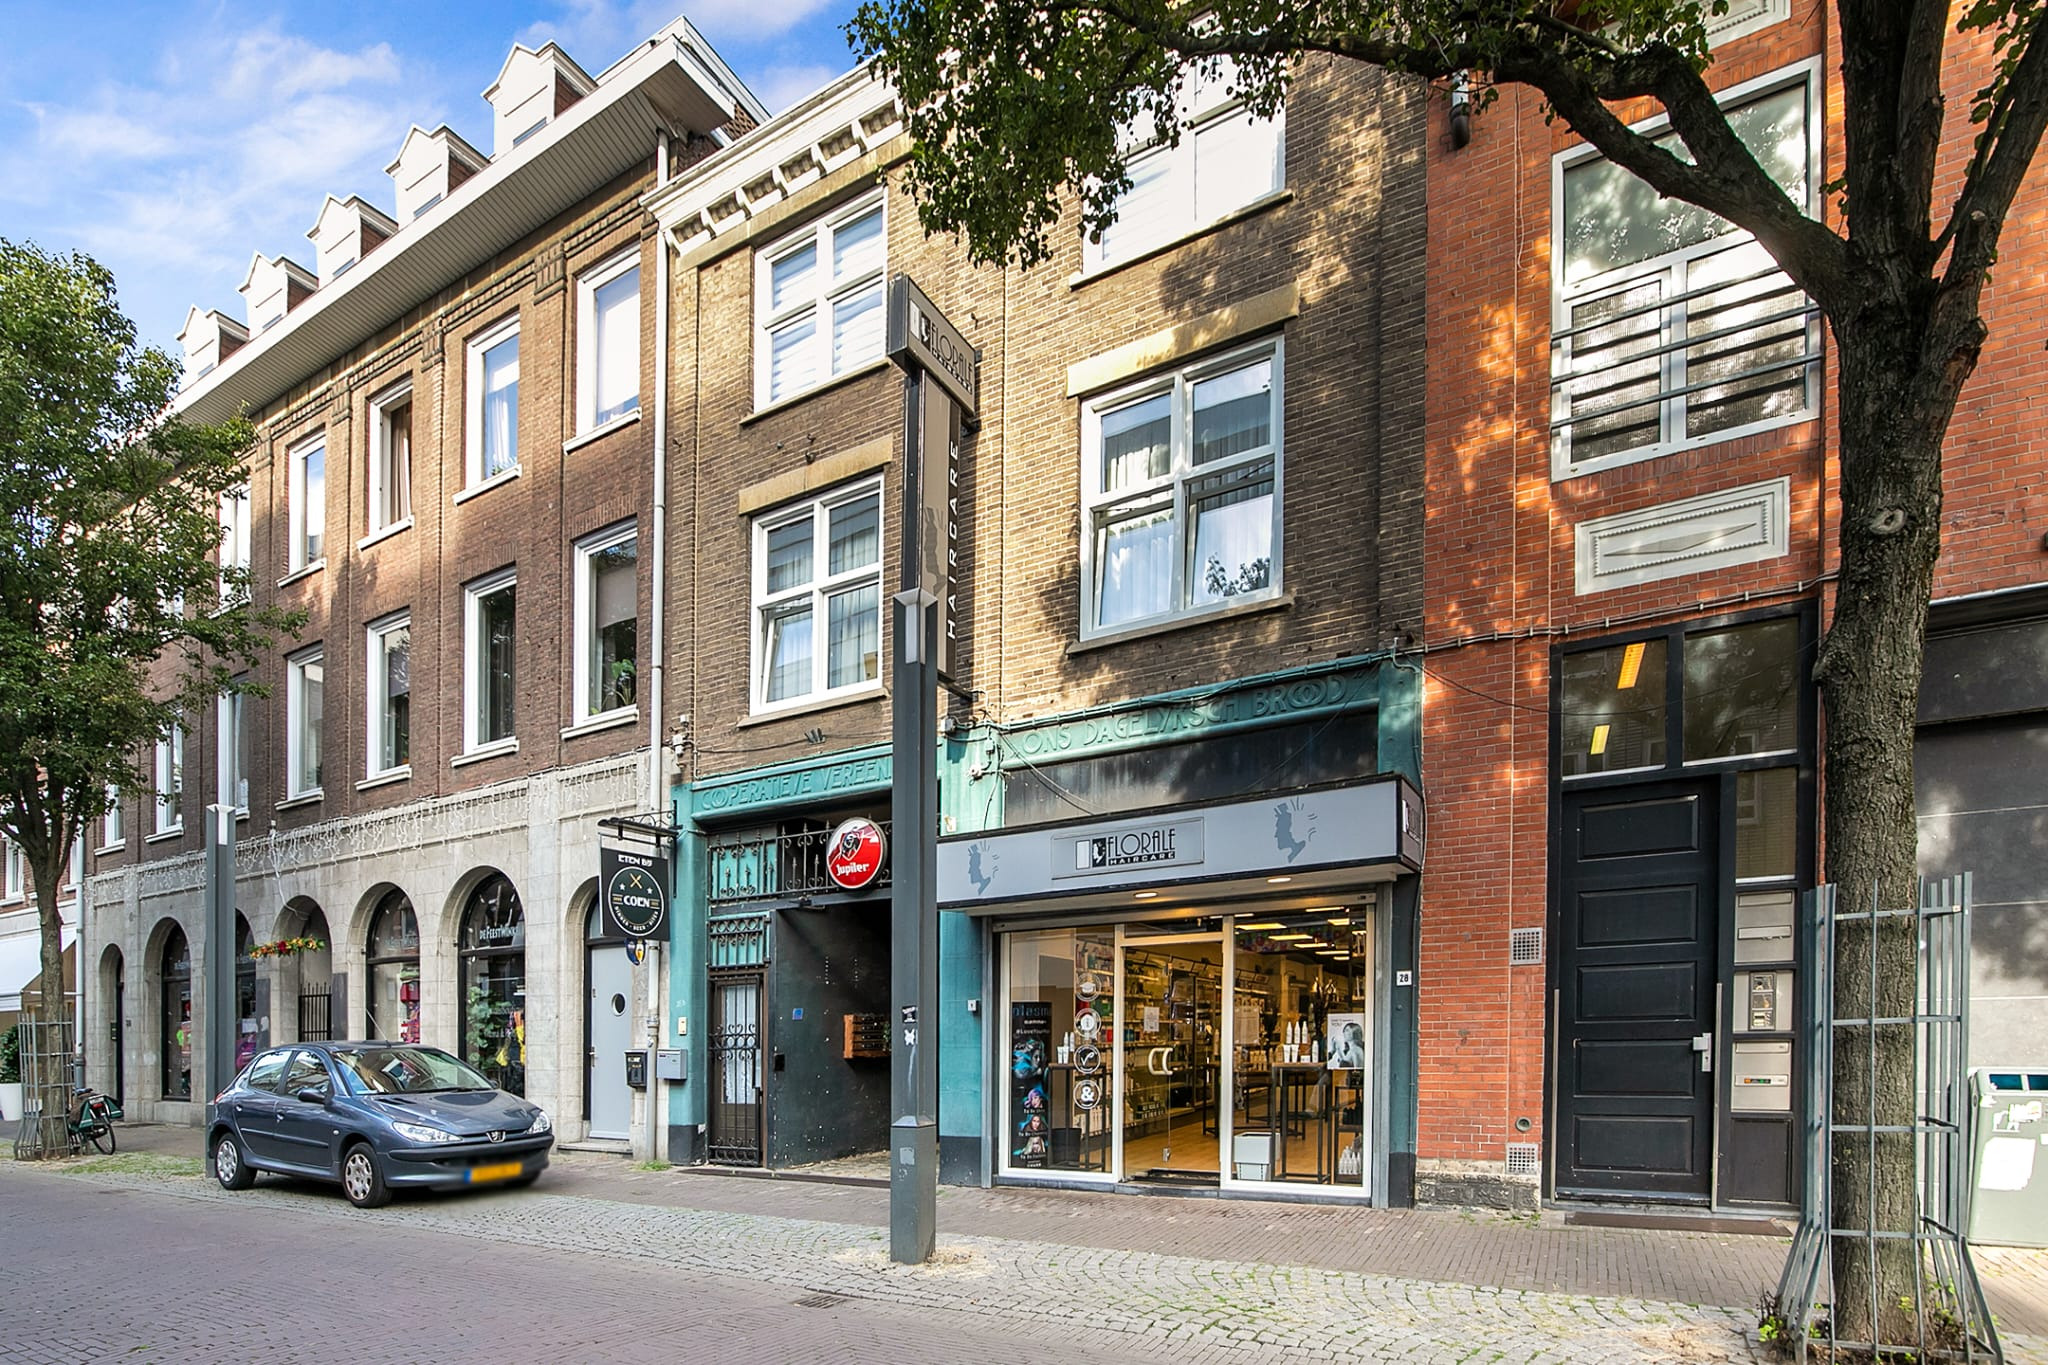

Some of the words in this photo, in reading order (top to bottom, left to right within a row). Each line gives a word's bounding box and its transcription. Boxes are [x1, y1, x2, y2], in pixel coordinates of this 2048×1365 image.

[947, 441, 959, 640] HAIRCARE
[1023, 723, 1072, 755] ONS
[1107, 828, 1176, 858] FLORALE
[617, 854, 640, 866] ETEN
[1109, 851, 1175, 866] HAIRCARE
[836, 862, 869, 877] Jupiler
[623, 895, 650, 908] COEN
[1399, 973, 1409, 983] 28
